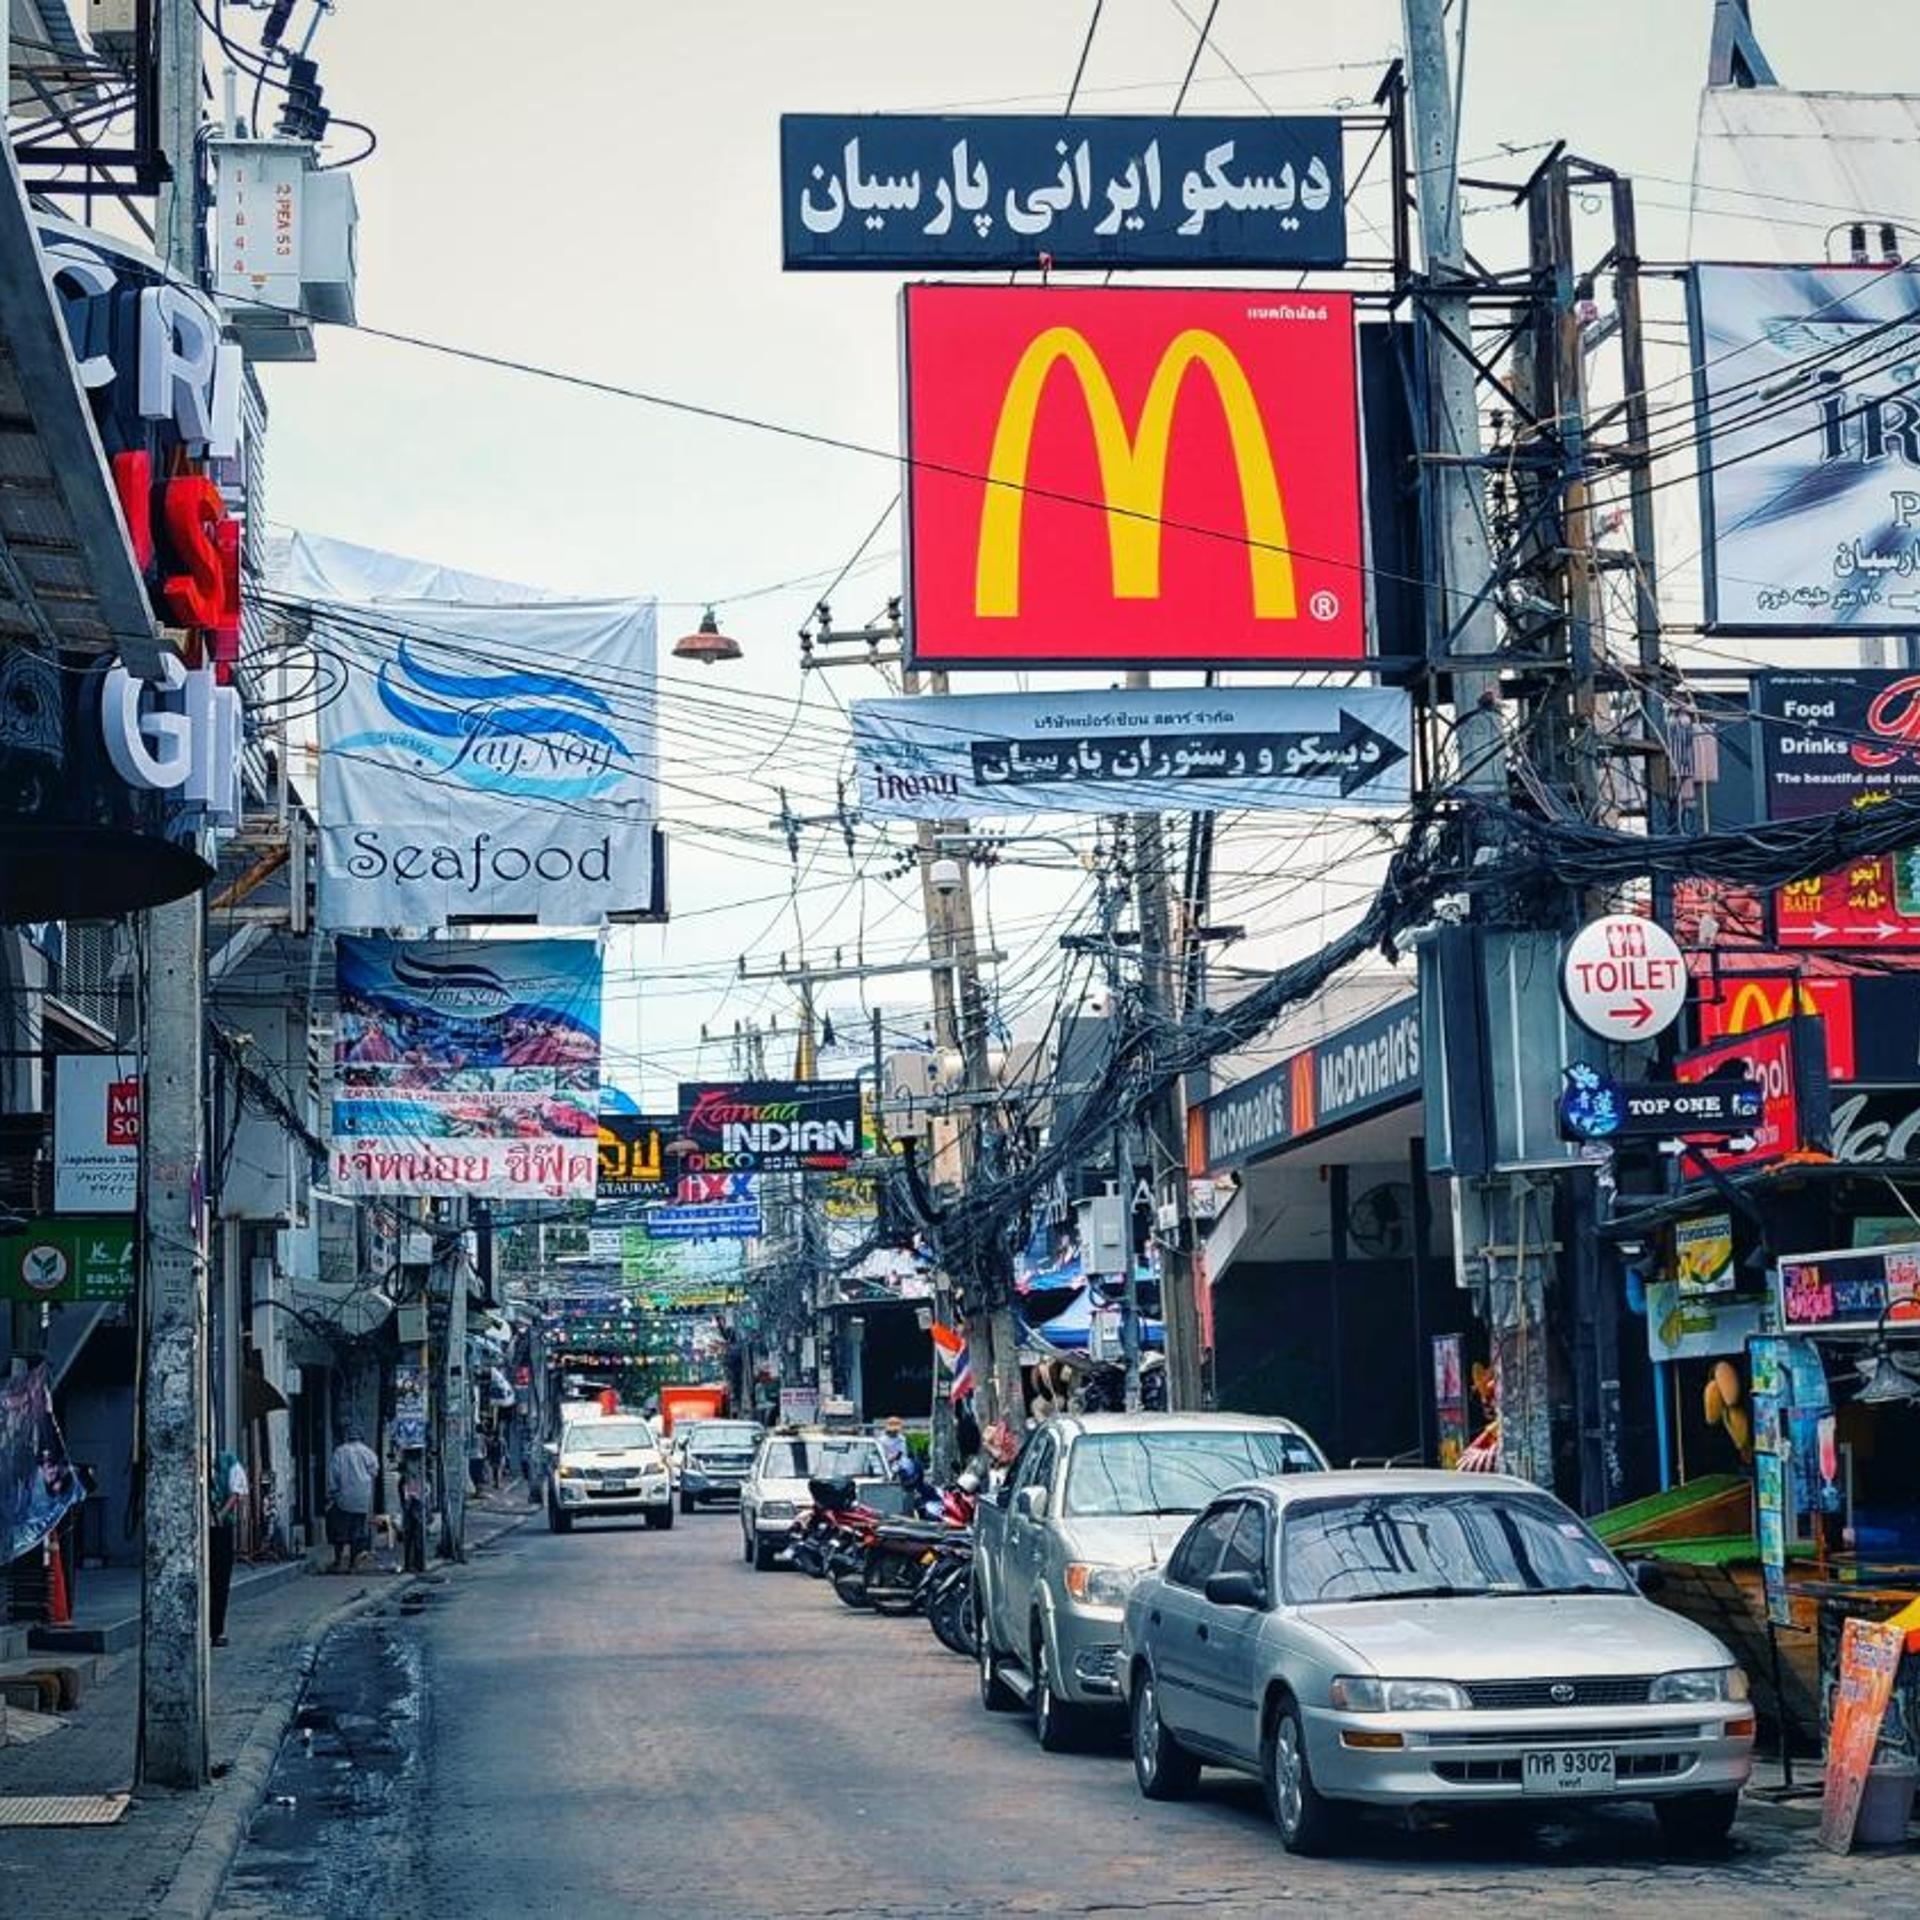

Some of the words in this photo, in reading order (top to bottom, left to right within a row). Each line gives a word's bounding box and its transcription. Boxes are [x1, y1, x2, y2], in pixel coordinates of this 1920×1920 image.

[801, 135, 990, 238] پارسیان
[1005, 138, 1160, 236] ایرانی
[1178, 140, 1332, 236] دیسکو
[1784, 701, 1836, 718] Food
[1780, 736, 1850, 754] Drinks
[1776, 773, 1802, 784] The
[1804, 773, 1864, 784] beautiful
[1866, 773, 1891, 784] and
[347, 831, 612, 893] Seafood
[1576, 959, 1679, 994] TOILET
[1320, 1016, 1420, 1114] McDonald's
[1210, 1081, 1286, 1161] McDonald's
[1629, 1098, 1670, 1116] TOP
[1674, 1095, 1721, 1114] ONE
[722, 1120, 855, 1153] INDIAN
[688, 1153, 755, 1171] DISCO
[1562, 1752, 1612, 1774] 9302
